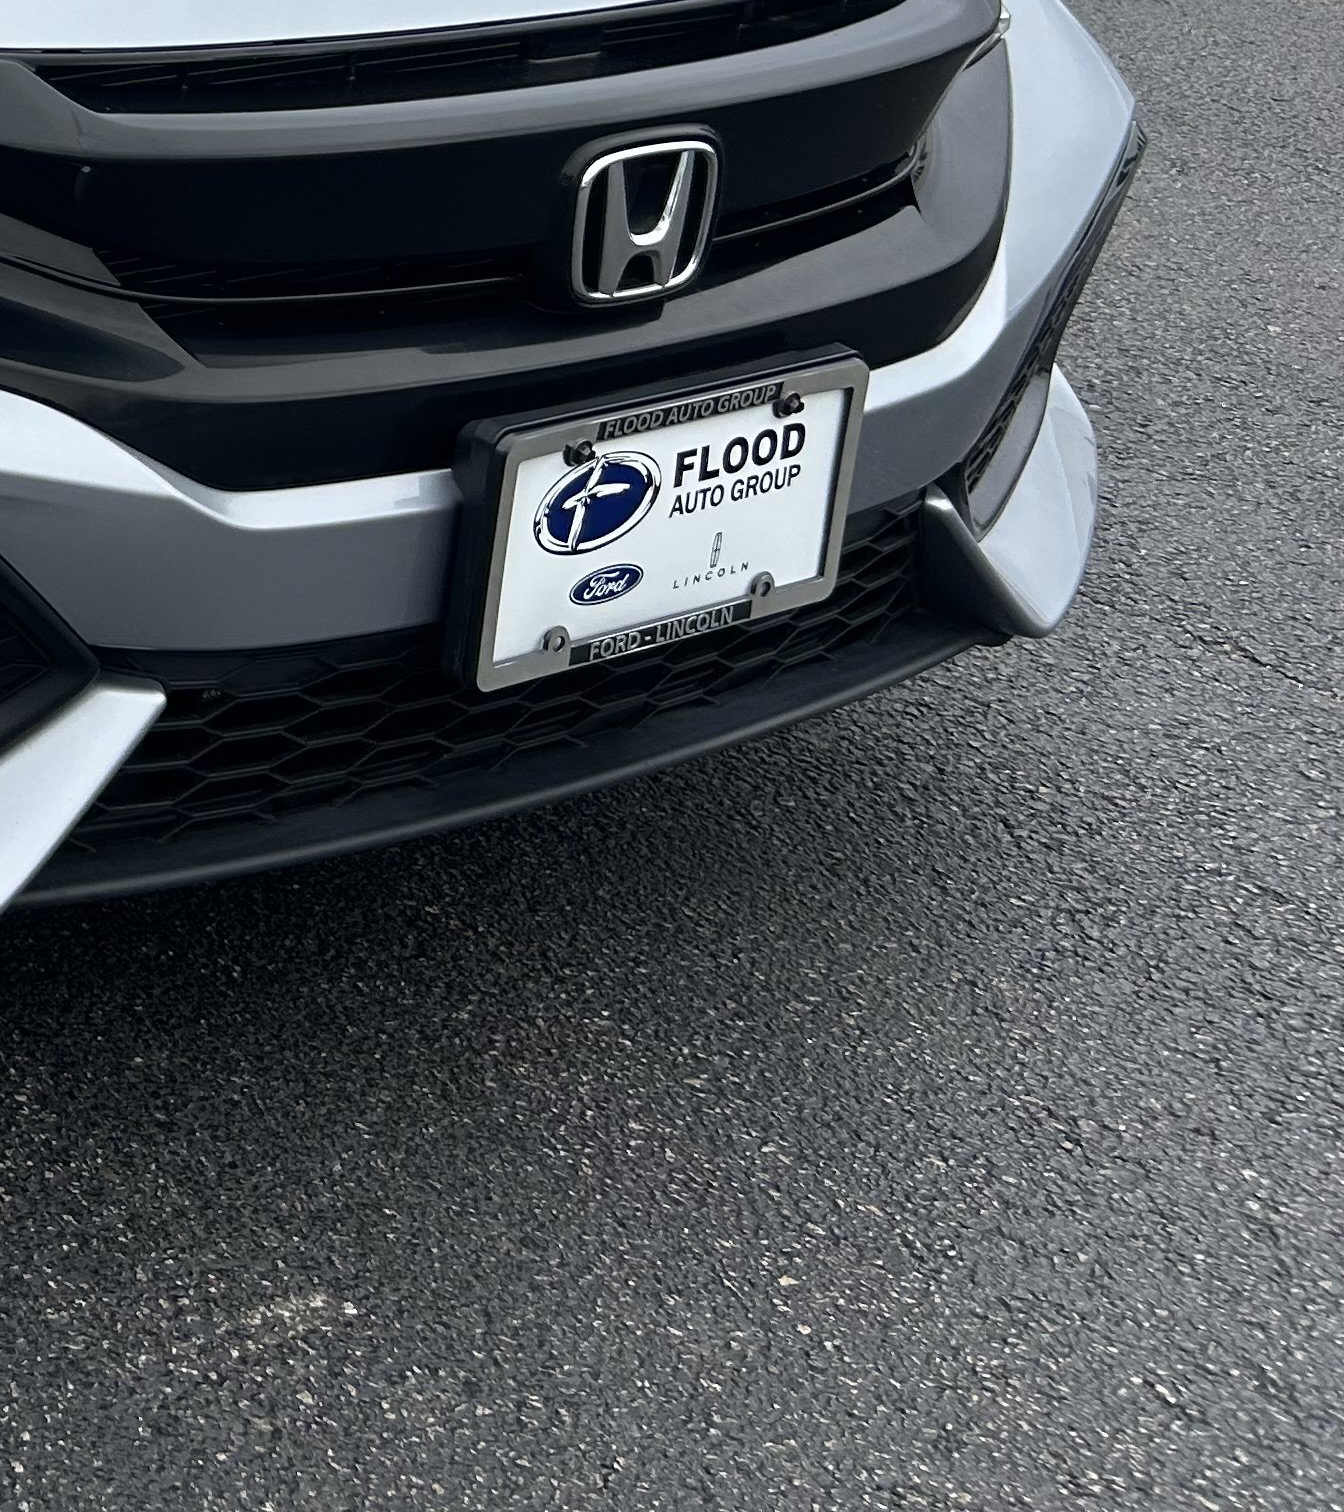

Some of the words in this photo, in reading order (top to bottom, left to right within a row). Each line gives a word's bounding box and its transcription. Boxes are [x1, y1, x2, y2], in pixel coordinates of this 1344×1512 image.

[603, 410, 662, 439] FLOOD
[665, 399, 715, 425] AUTO
[717, 384, 776, 413] GROUP
[673, 422, 806, 489] FLOOD
[668, 484, 725, 518] AUTO
[730, 464, 801, 502] GROUP
[583, 571, 630, 600] Ford
[672, 561, 750, 589] LINCOLN
[589, 631, 641, 661] FORD
[655, 605, 734, 643] LINCOLN
